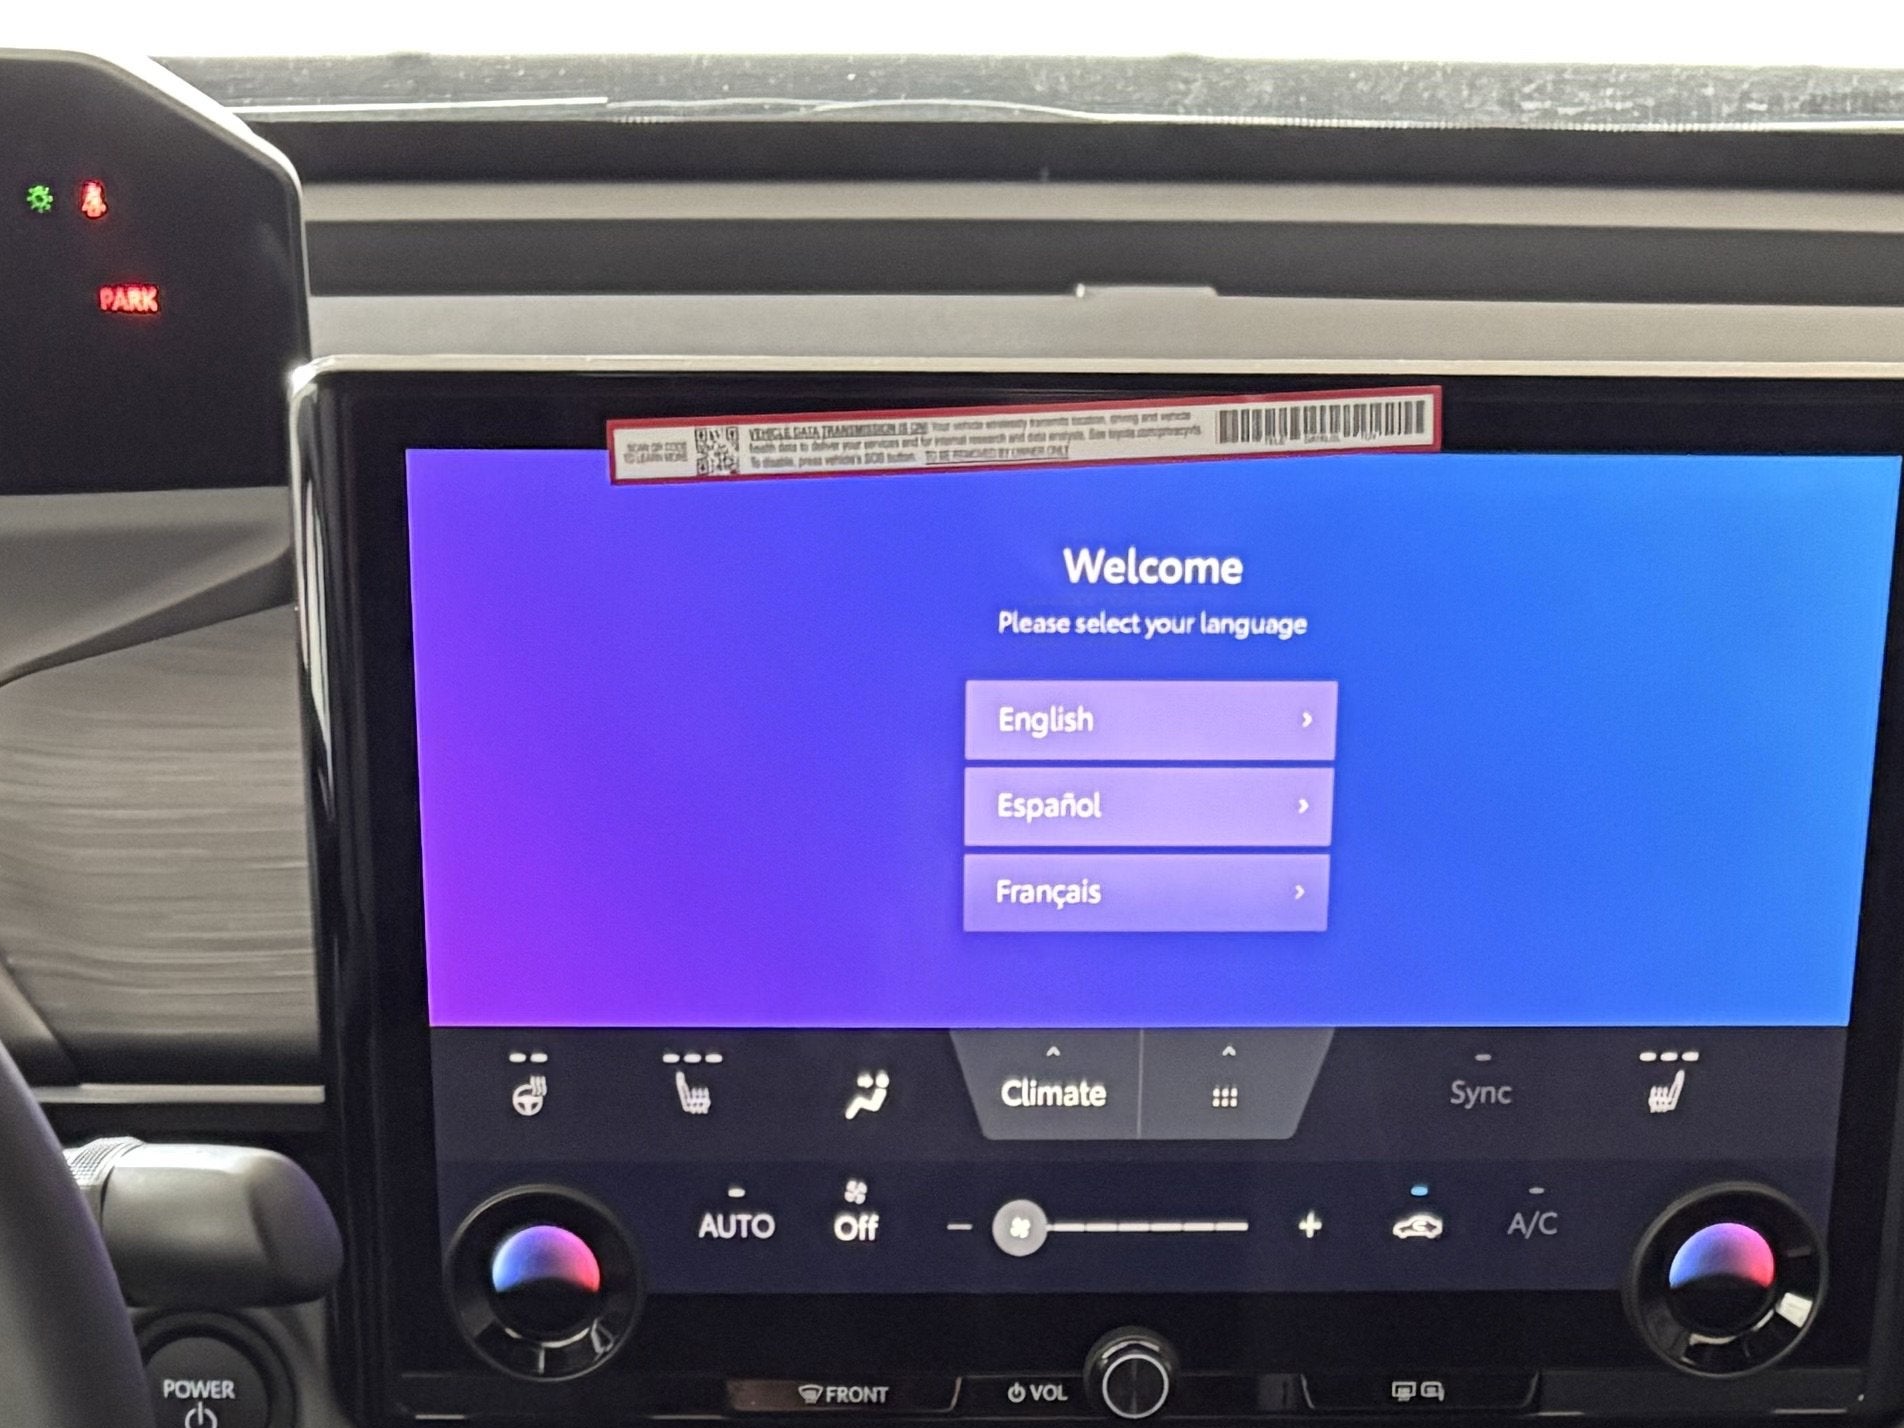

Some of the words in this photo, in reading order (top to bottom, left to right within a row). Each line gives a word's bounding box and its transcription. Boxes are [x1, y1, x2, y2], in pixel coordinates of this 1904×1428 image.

[99, 286, 160, 314] PARK
[1063, 546, 1243, 584] Welcome
[998, 609, 1070, 635] Please
[1075, 611, 1140, 635] select
[1144, 616, 1195, 640] your
[1200, 611, 1308, 641] language
[998, 705, 1094, 739] English
[997, 791, 1102, 824] Español
[996, 878, 1102, 910] Français
[1001, 1079, 1107, 1107] Climate
[1450, 1080, 1512, 1109] Sync
[699, 1213, 776, 1239] AUTO
[833, 1213, 879, 1242] Off
[1508, 1212, 1558, 1239] A/C
[163, 1378, 236, 1400] POWER
[826, 1387, 889, 1404] FRONT
[1029, 1384, 1068, 1402] VOL
